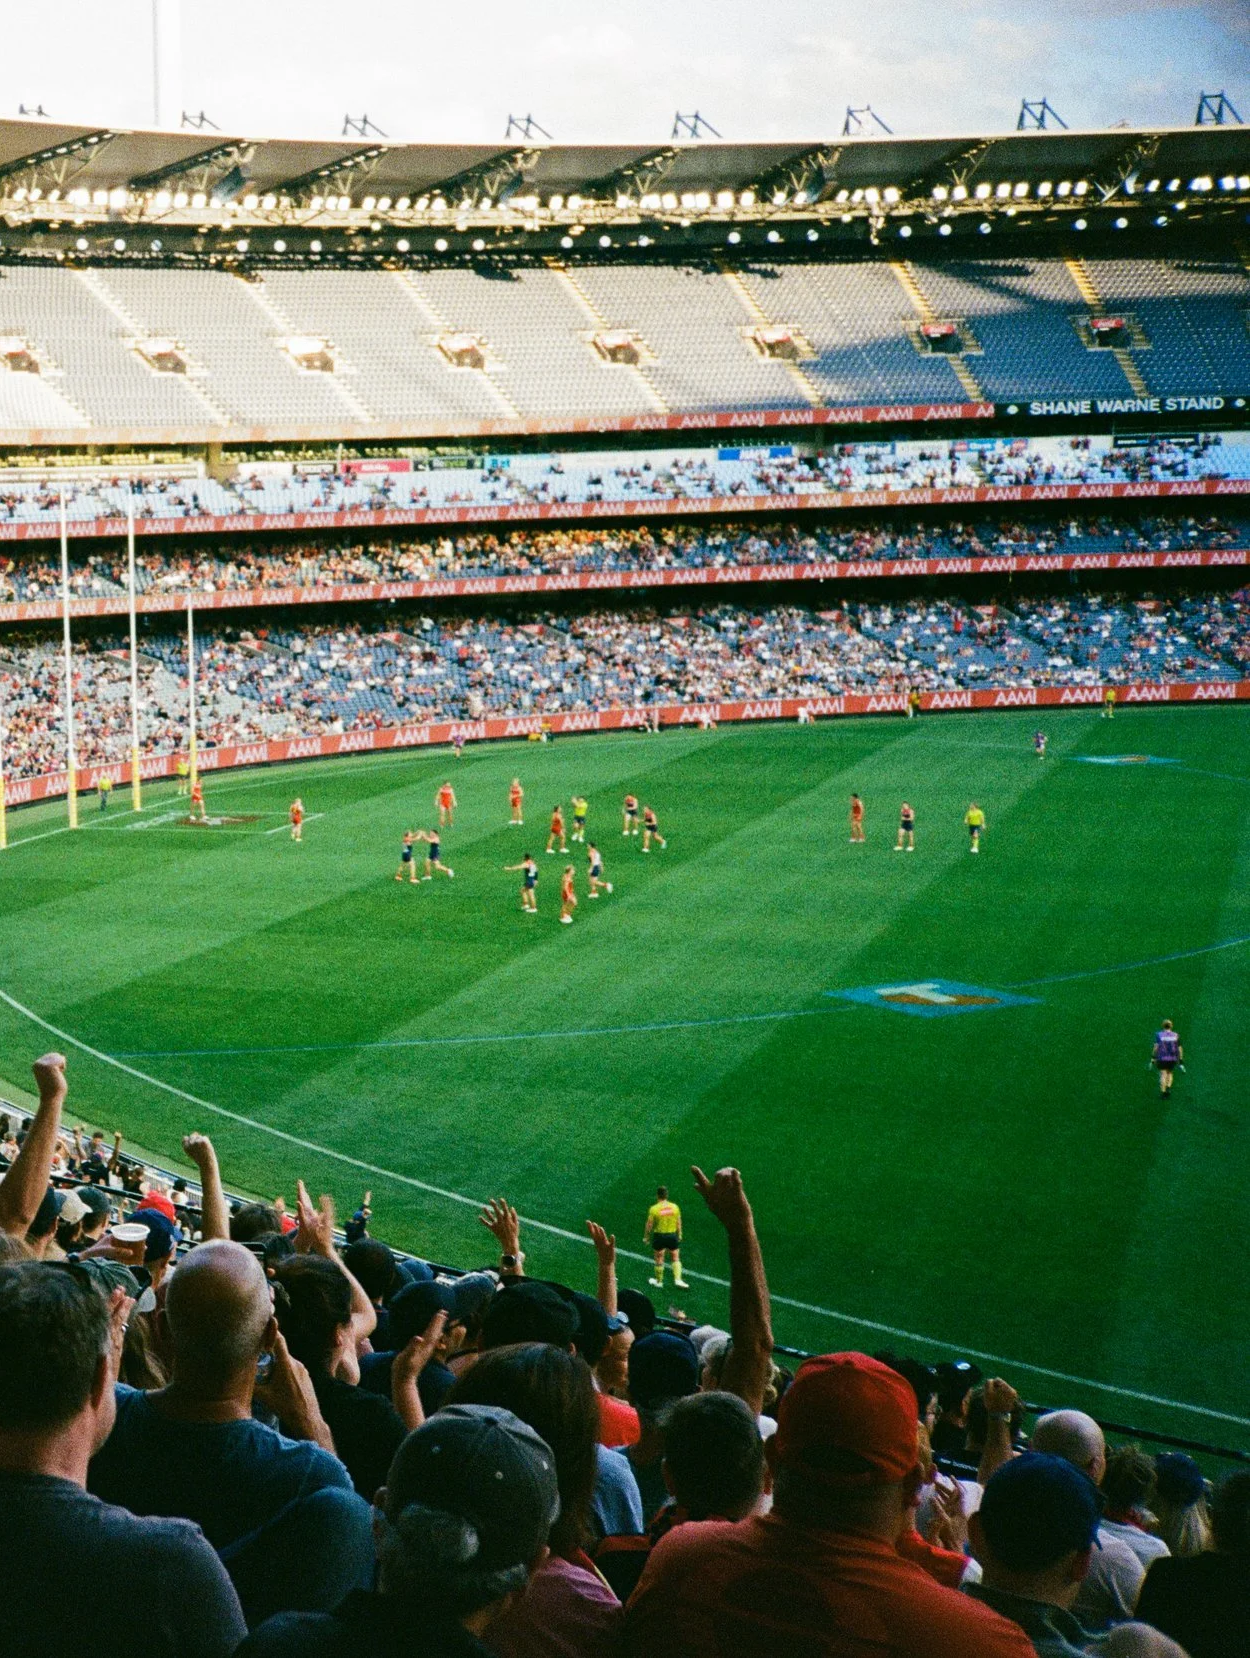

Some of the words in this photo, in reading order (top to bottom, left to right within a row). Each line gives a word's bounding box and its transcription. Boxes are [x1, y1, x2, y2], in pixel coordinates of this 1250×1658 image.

[587, 417, 620, 430] AAMI
[633, 416, 667, 429] AAMI
[681, 414, 716, 428] AAMI
[729, 413, 764, 426] AAMI
[779, 411, 813, 424] AAMI
[827, 410, 863, 423] AAMI
[877, 408, 912, 420] AAMI
[926, 406, 962, 419] AAMI
[1030, 401, 1091, 415] SHANE
[1097, 399, 1160, 412] WARNE
[1166, 397, 1224, 411] STAND
[26, 522, 56, 539] AAMI
[67, 520, 96, 537] AAMI
[104, 519, 129, 536] AAM
[144, 518, 174, 534] AAMI
[184, 517, 215, 532] AAMI
[224, 516, 254, 530] AAMI
[262, 514, 294, 529] AAMI
[302, 512, 334, 527] AAMI
[343, 511, 374, 526] AAMI
[383, 510, 415, 524] AAMI
[424, 508, 457, 522] AAMI
[466, 506, 498, 520] AAMI
[508, 504, 540, 518] AAMI
[550, 502, 582, 517] AAMI
[592, 502, 624, 516] AAMI
[634, 500, 666, 514] AAMI
[676, 499, 710, 512] AAMI
[721, 498, 754, 510] AAMI
[766, 496, 799, 508] AAMI
[808, 494, 841, 507] AAMI
[852, 492, 886, 505] AAMI
[896, 490, 931, 503] AAMI
[942, 488, 976, 502] AAMI
[987, 487, 1022, 500] AAMI
[1032, 486, 1068, 498] AAMI
[1079, 484, 1113, 497] AAMI
[1124, 483, 1159, 496] AAMI
[1170, 482, 1206, 494] AAMI
[1216, 480, 1250, 494] AAMI
[26, 603, 56, 618] AAMI
[67, 600, 97, 616] AAMI
[104, 599, 130, 614] AAM
[142, 596, 174, 612] AAMI
[183, 594, 214, 608] AAMI
[222, 592, 252, 607] AAMI
[262, 590, 292, 604] AAMI
[301, 587, 332, 602] AAMI
[342, 585, 373, 600] AAMI
[380, 583, 413, 598] AAMI
[422, 581, 455, 596] AAMI
[463, 579, 496, 594] AAMI
[504, 577, 536, 592] AAMI
[546, 576, 580, 590] AAMI
[588, 574, 622, 588] AAMI
[630, 572, 663, 586] AAMI
[673, 570, 706, 584] AAMI
[716, 568, 750, 582] AAMI
[760, 566, 794, 580] AAMI
[803, 564, 837, 578] AAMI
[846, 562, 882, 576] AAMI
[892, 560, 927, 575] AAMI
[936, 559, 971, 573] AAMI
[980, 558, 1016, 572] AAMI
[1026, 556, 1062, 570] AAMI
[1072, 555, 1108, 569] AAMI
[1117, 554, 1154, 568] AAMI
[1164, 552, 1200, 566] AAMI
[1210, 551, 1246, 565] AAMI
[4, 783, 31, 801] AAMI
[46, 776, 70, 795] AAM
[138, 762, 168, 779] AAMI
[235, 744, 268, 764] AAMI
[287, 738, 321, 758] AAMI
[339, 732, 374, 751] AAMI
[394, 727, 430, 746] AAMI
[448, 722, 486, 740] AAMI
[504, 718, 542, 736] AAMI
[562, 712, 600, 730] AAMI
[742, 702, 781, 718] AAMI
[805, 698, 844, 715] AAMI
[867, 694, 908, 712] AAMI
[930, 692, 972, 709] AAMI
[996, 690, 1037, 706] AAMI
[1060, 688, 1102, 704] AAMI
[1126, 686, 1170, 702] AAMI
[1194, 684, 1236, 700] AAMI
